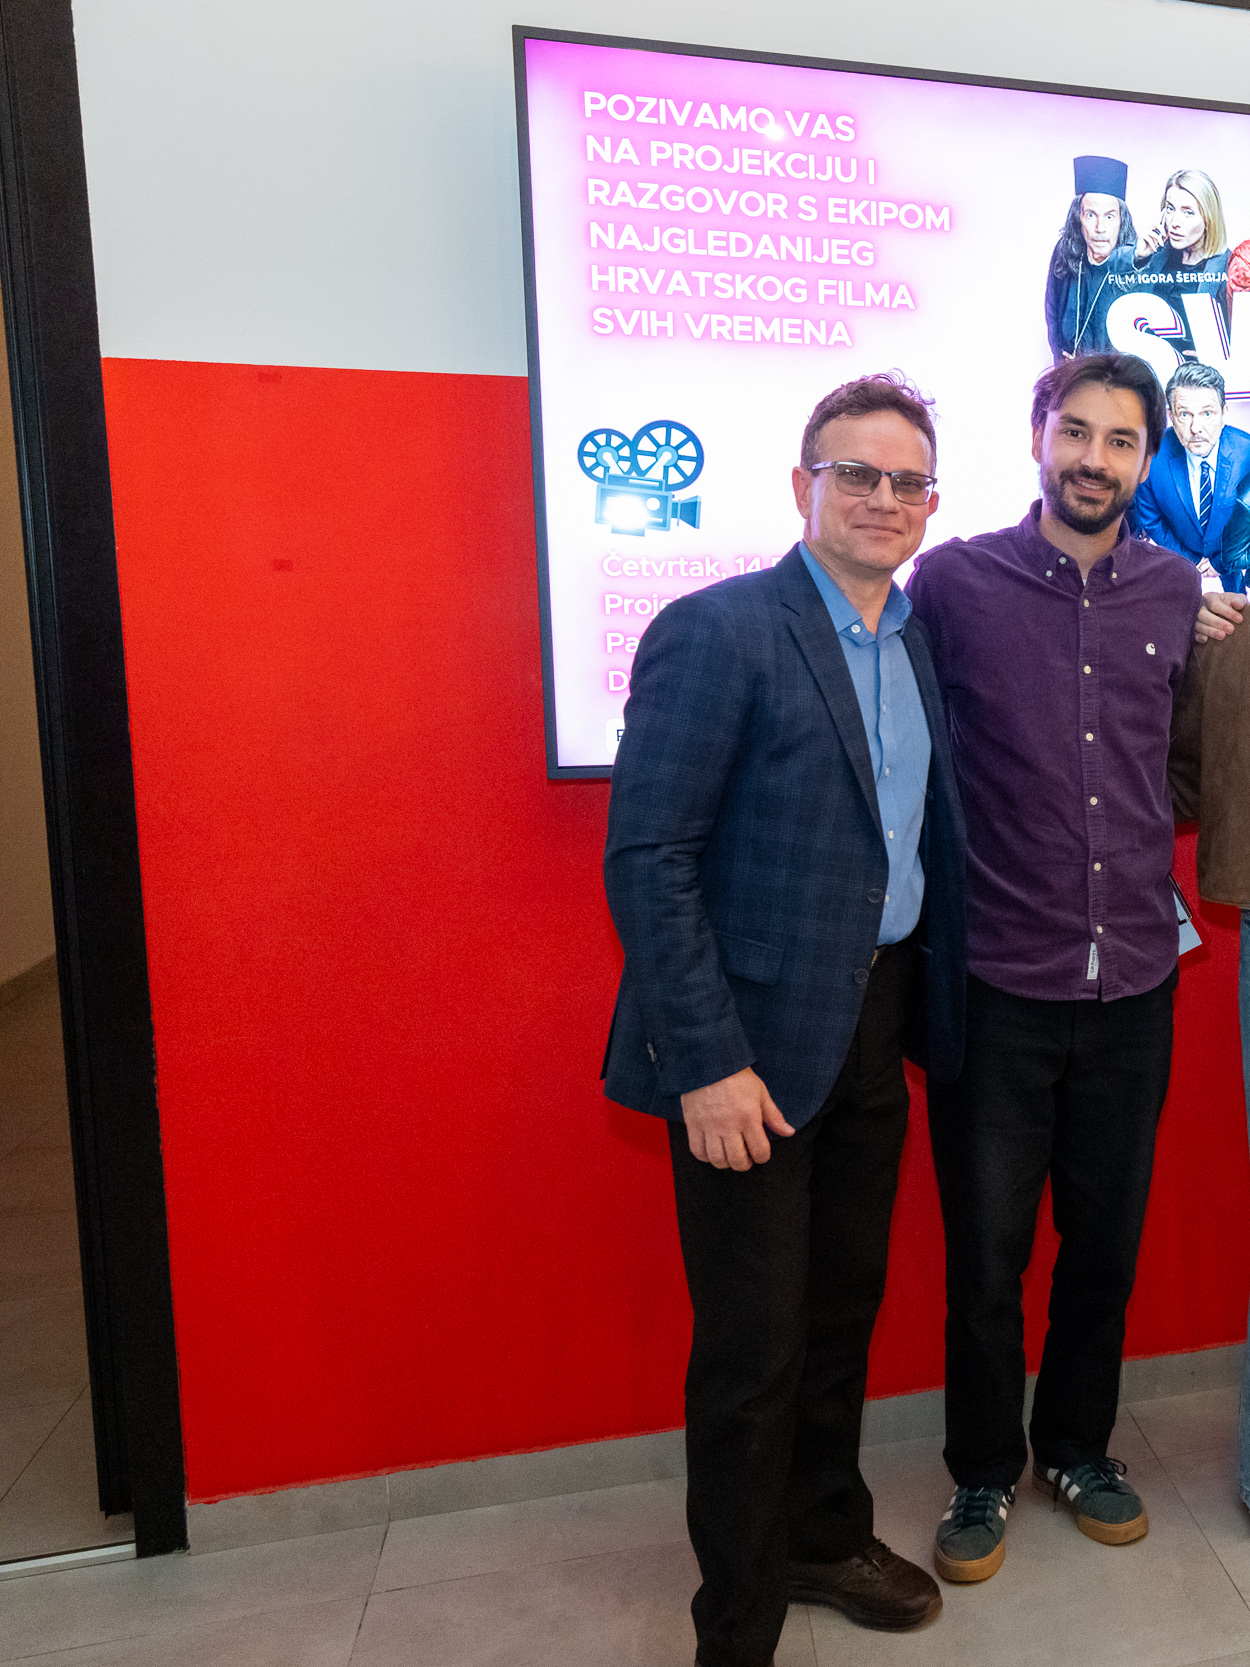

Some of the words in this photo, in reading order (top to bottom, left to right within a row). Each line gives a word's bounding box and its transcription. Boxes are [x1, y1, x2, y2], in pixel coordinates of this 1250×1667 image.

[584, 91, 776, 133] POZIVAMO
[784, 110, 856, 142] VAS
[586, 135, 640, 165] NA
[650, 140, 858, 184] PROJEKCIJU
[868, 159, 876, 185] I
[588, 178, 788, 219] RAZGOVOR
[798, 194, 818, 220] S
[828, 198, 951, 232] EKIPOM
[589, 222, 875, 266] NAJGLEDANIJEG
[591, 265, 808, 303] HRVATSKOG
[818, 279, 916, 309] FILMA
[1108, 274, 1136, 285] FILM
[1138, 273, 1174, 284] IGORA
[1176, 271, 1229, 284] ŠEREGIJA
[592, 308, 674, 338] SVIH
[684, 313, 852, 346] VREMENA
[602, 549, 727, 580] Četvrtak,
